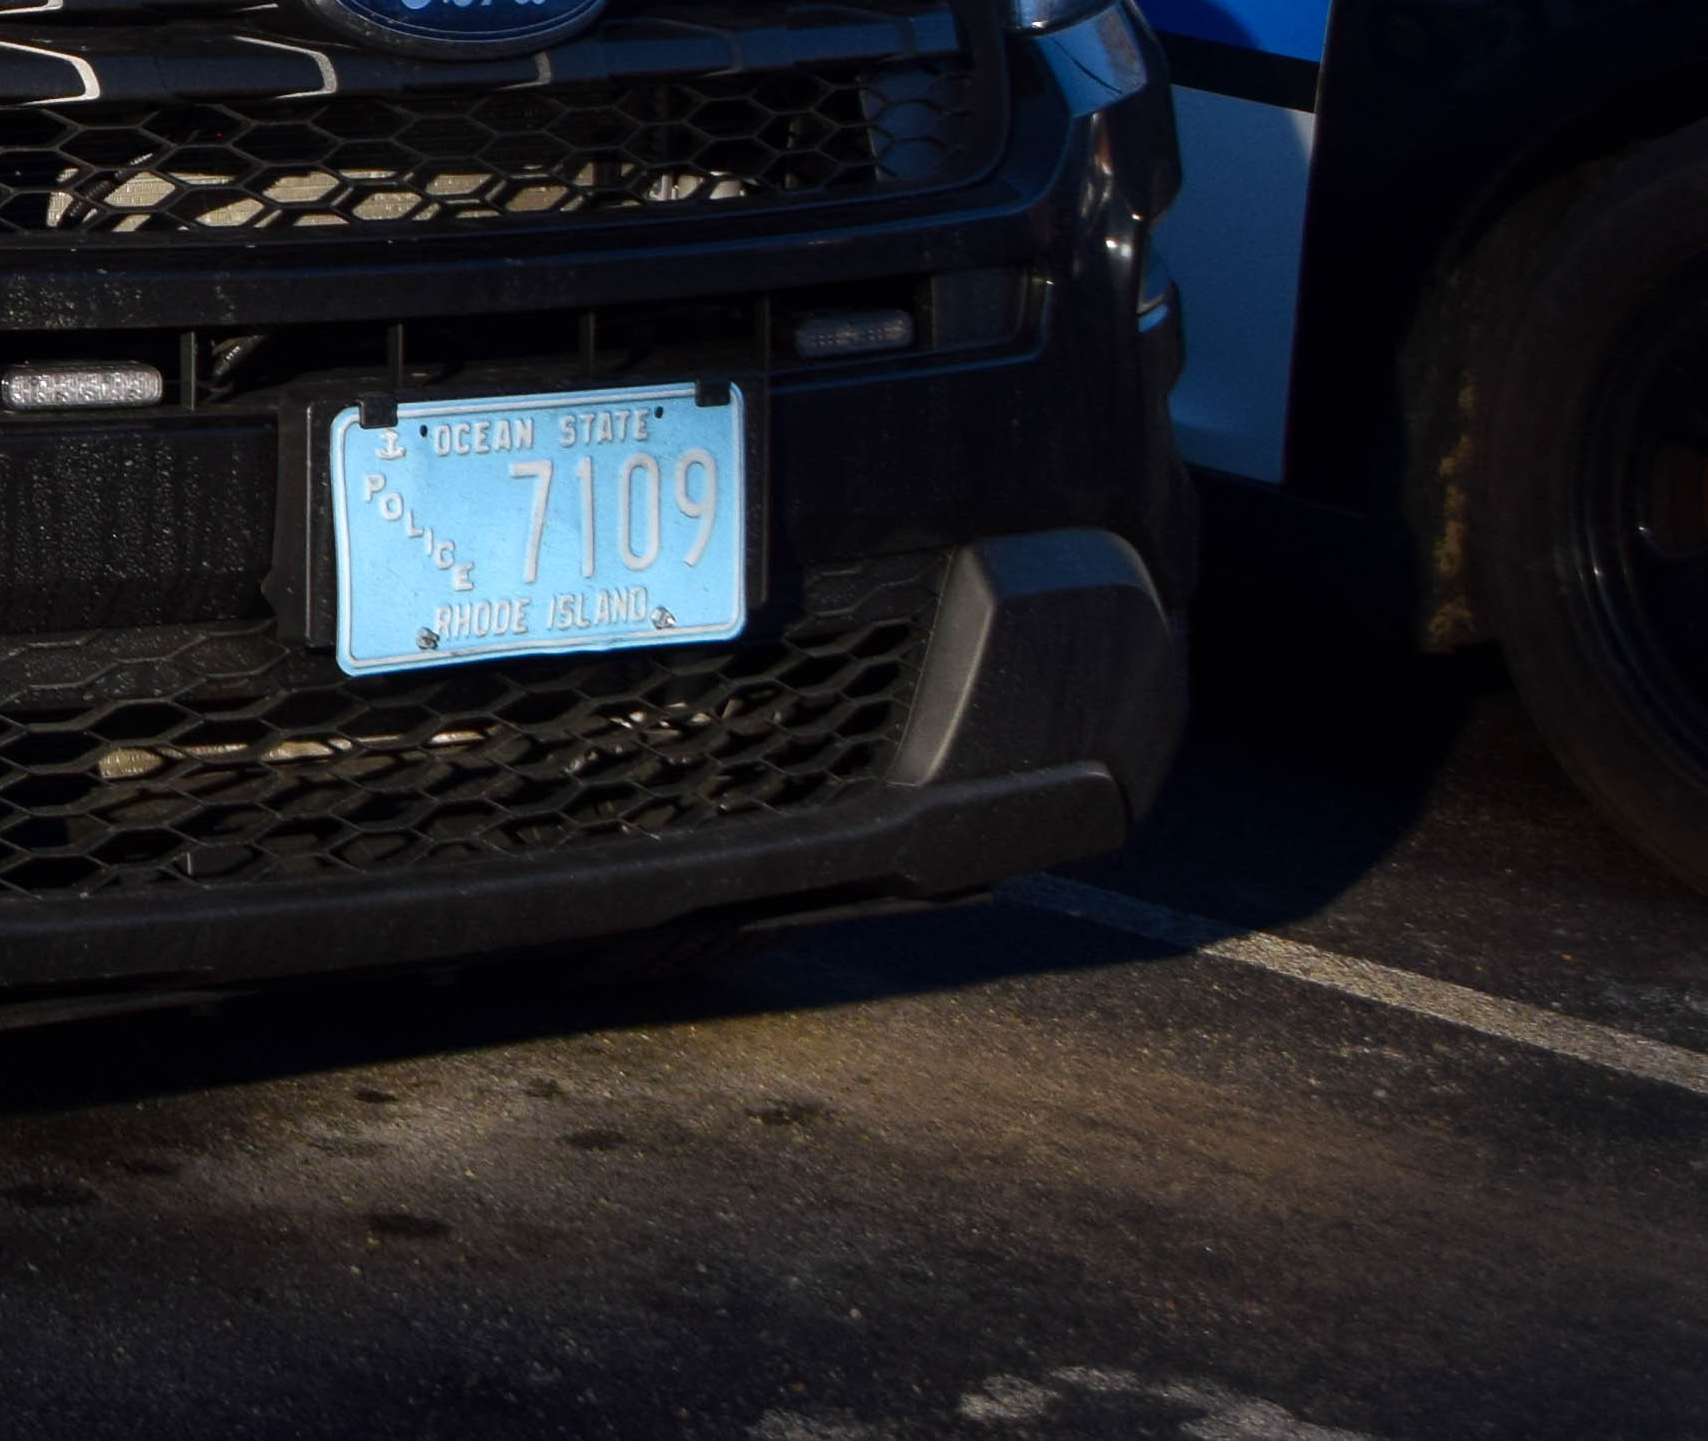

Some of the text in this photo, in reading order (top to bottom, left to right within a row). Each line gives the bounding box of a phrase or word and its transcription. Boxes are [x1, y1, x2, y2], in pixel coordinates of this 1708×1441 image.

[434, 410, 649, 457] OCEAN STATE
[363, 474, 474, 591] POLICE
[509, 448, 717, 583] 7109
[433, 586, 648, 638] RHODE ISLAND
